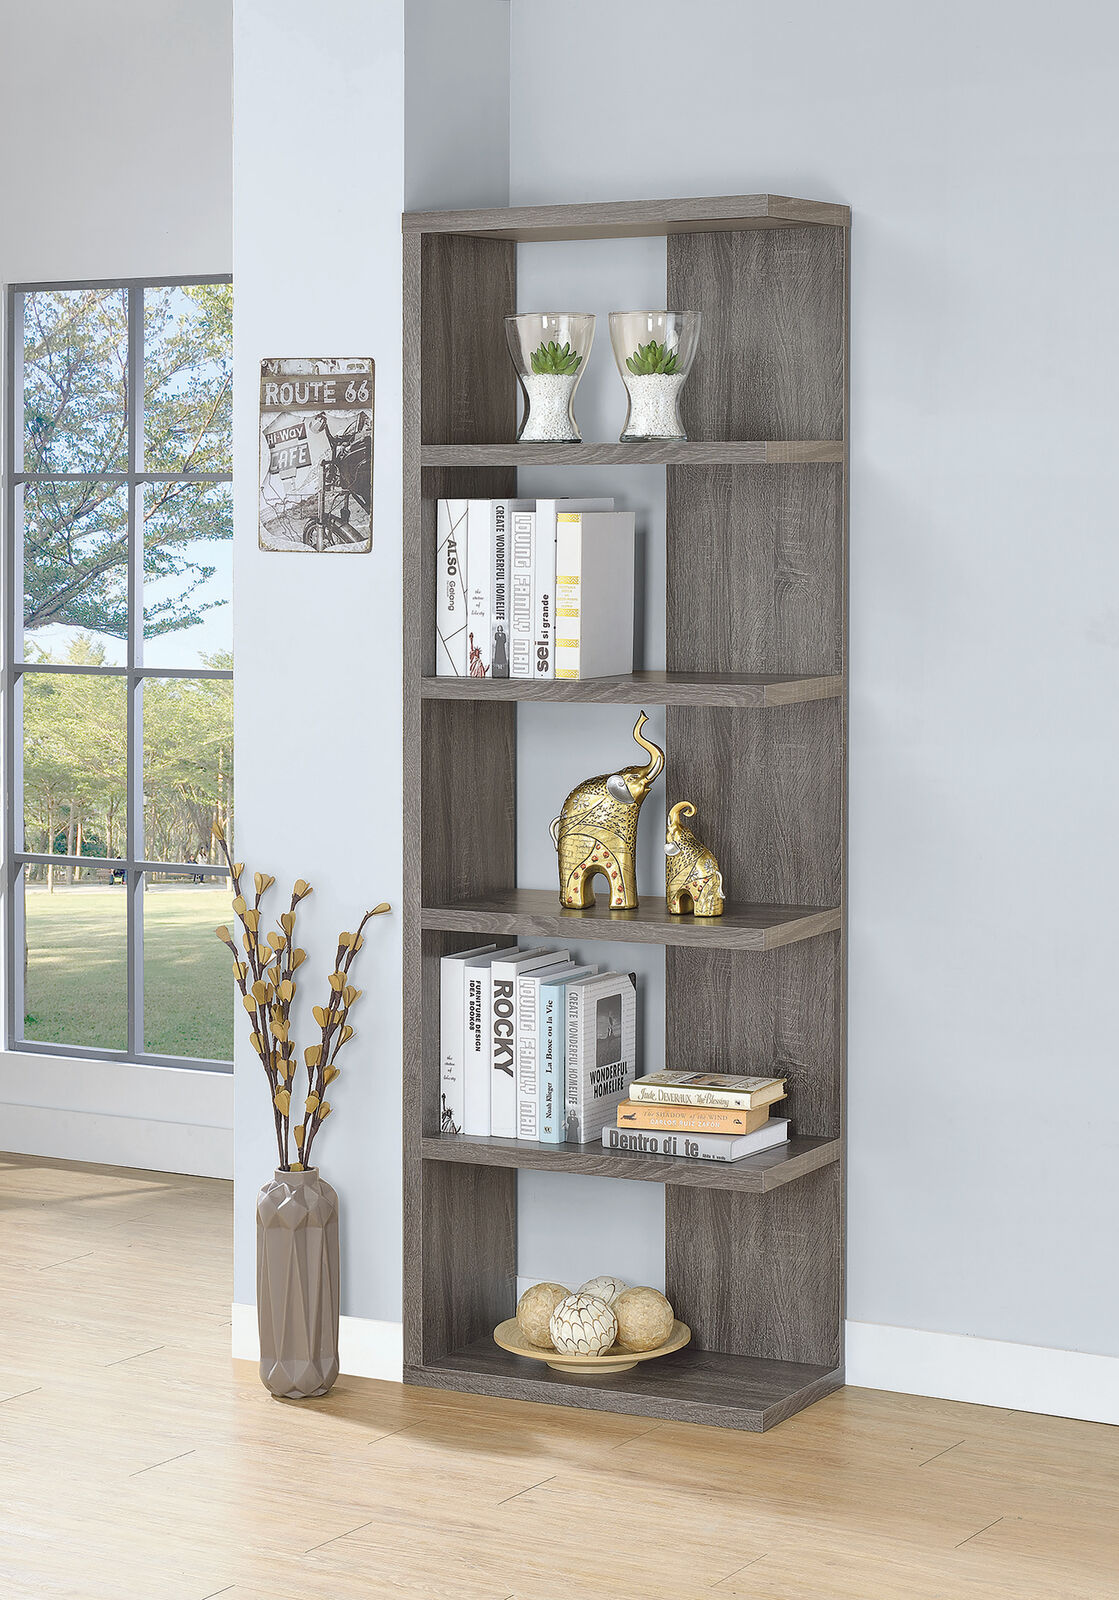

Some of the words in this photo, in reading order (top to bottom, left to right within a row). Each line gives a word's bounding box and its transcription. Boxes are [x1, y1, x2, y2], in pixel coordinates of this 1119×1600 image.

[265, 380, 337, 406] ROUTE
[345, 380, 369, 403] 66
[270, 447, 308, 470] CAFE
[496, 505, 505, 532] CREATE
[447, 540, 457, 576] ALSO
[496, 534, 505, 581] WONDERFUL
[496, 583, 505, 620] HOMELIFE
[541, 594, 550, 628] grande
[535, 641, 549, 672] sei
[569, 991, 578, 1018] CREATE
[493, 980, 514, 1078] ROCKY
[547, 1026, 553, 1037] ou
[569, 1020, 578, 1066] WONDERFUL
[545, 1062, 553, 1074] La
[590, 1061, 628, 1085] WONDERFUL
[568, 1068, 578, 1105] HOMELIFE
[593, 1077, 624, 1099] HOMELIFE
[609, 1129, 658, 1152] Dentro
[662, 1136, 677, 1154] di
[684, 1138, 699, 1158] te
